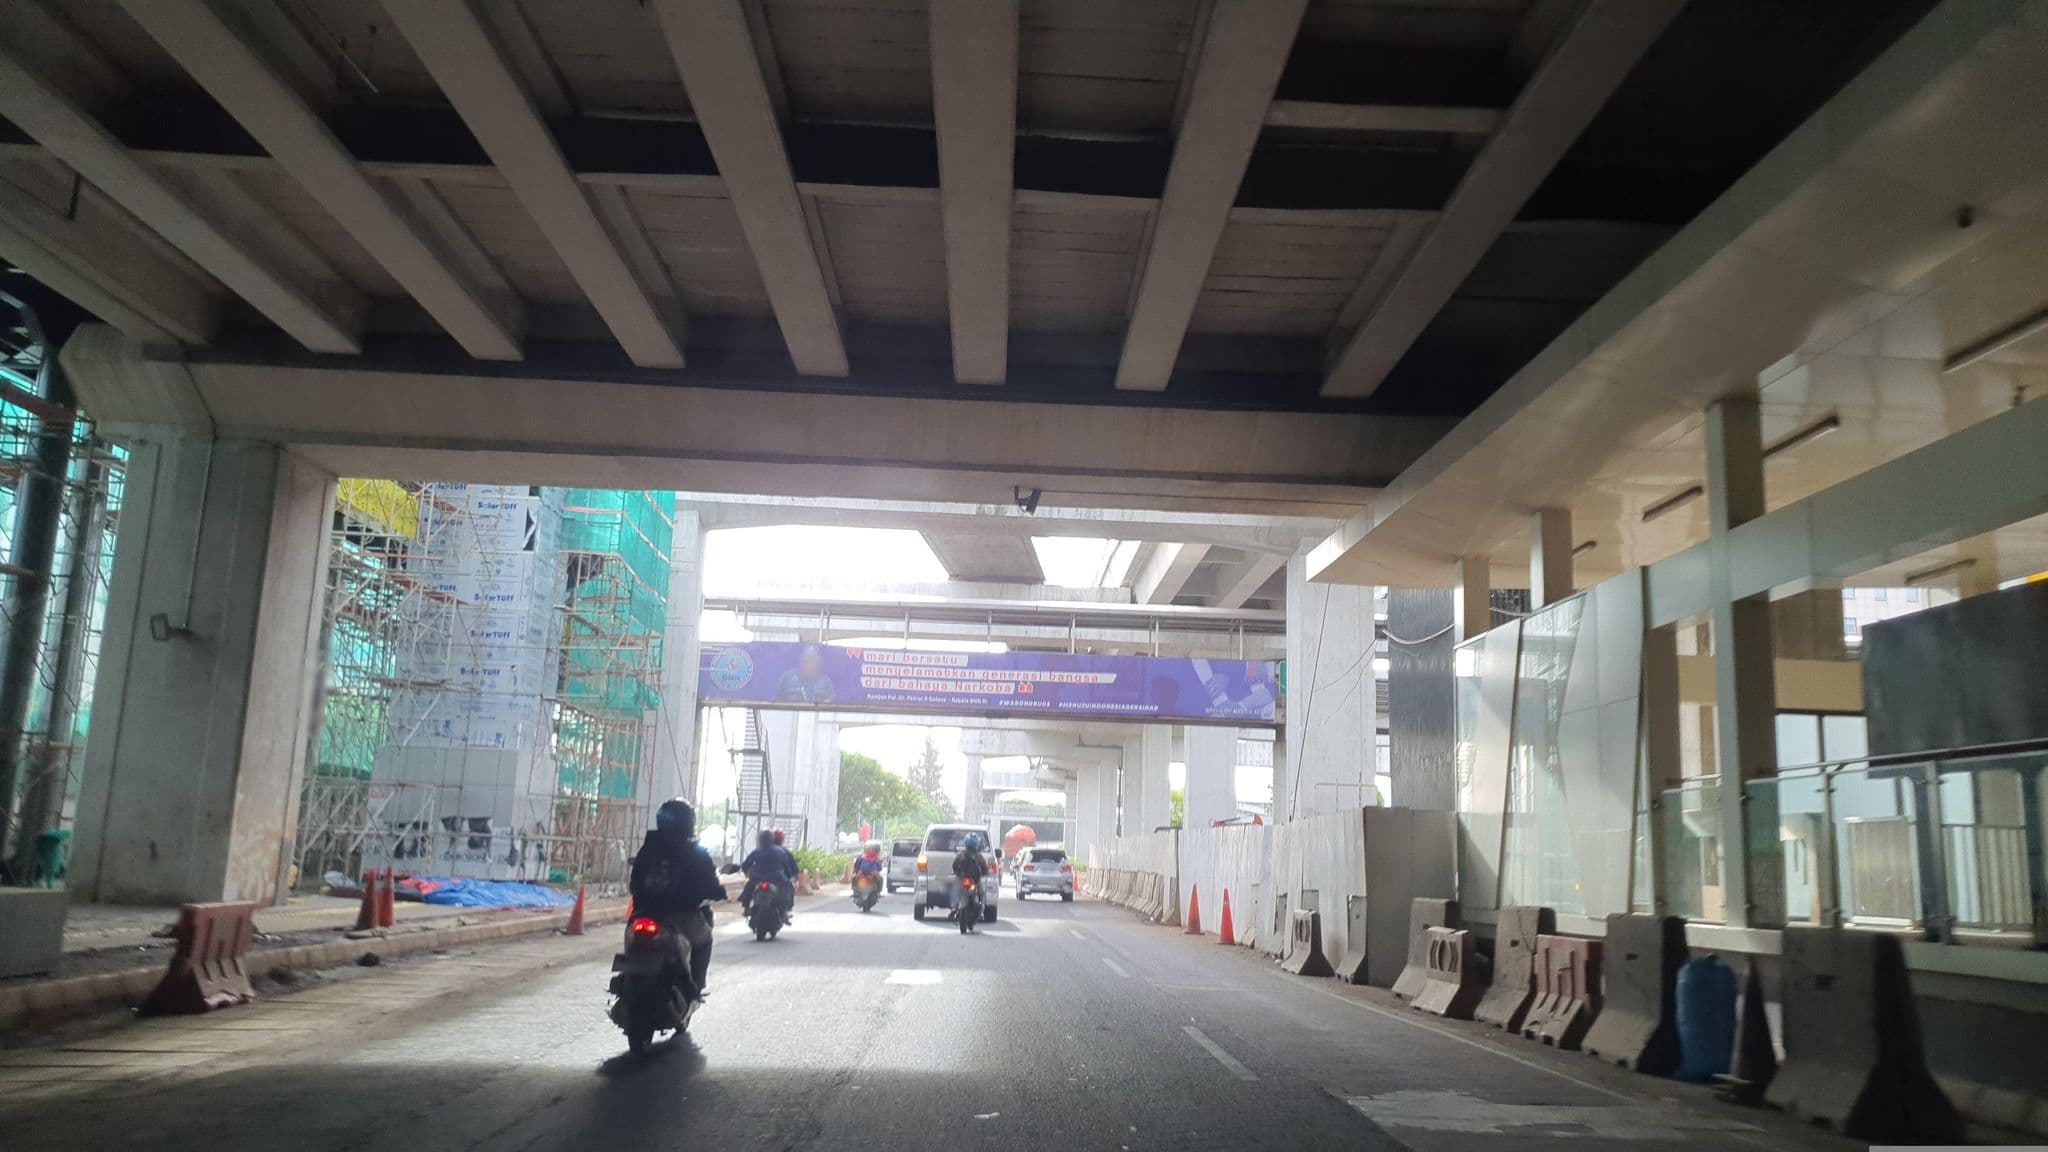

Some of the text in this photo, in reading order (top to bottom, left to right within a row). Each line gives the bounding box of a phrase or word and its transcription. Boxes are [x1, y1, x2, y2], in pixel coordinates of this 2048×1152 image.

[866, 652, 958, 664] mari bersatu
[865, 666, 1098, 684] menyelamatkan generasi bangsa
[864, 678, 1012, 692] dari bahaya Narkoba
